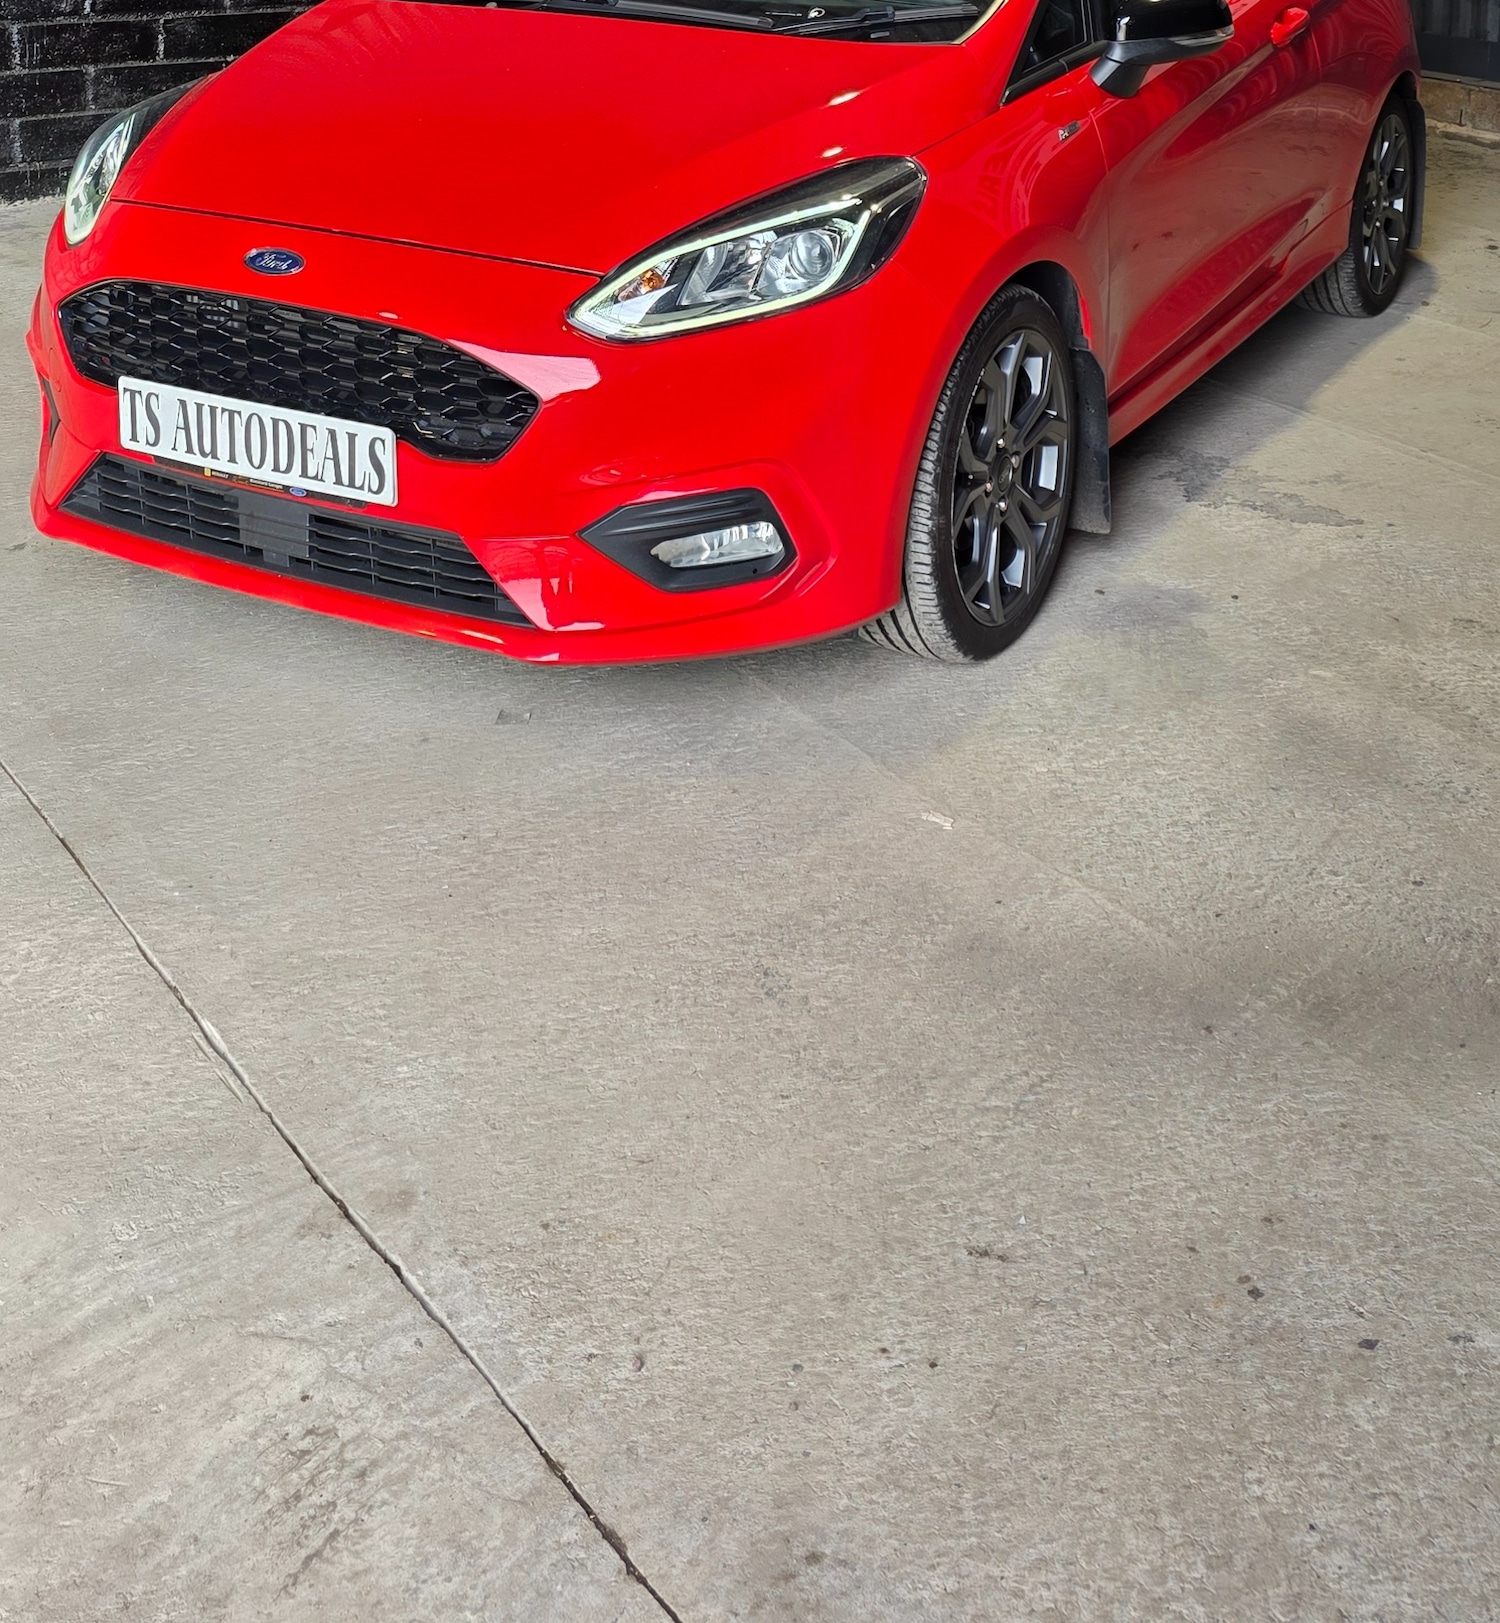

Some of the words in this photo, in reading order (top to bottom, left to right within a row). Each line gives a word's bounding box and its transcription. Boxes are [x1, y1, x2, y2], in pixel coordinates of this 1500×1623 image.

[255, 252, 293, 271] Ford
[122, 387, 161, 448] TS
[171, 398, 386, 496] AUTODEALS
